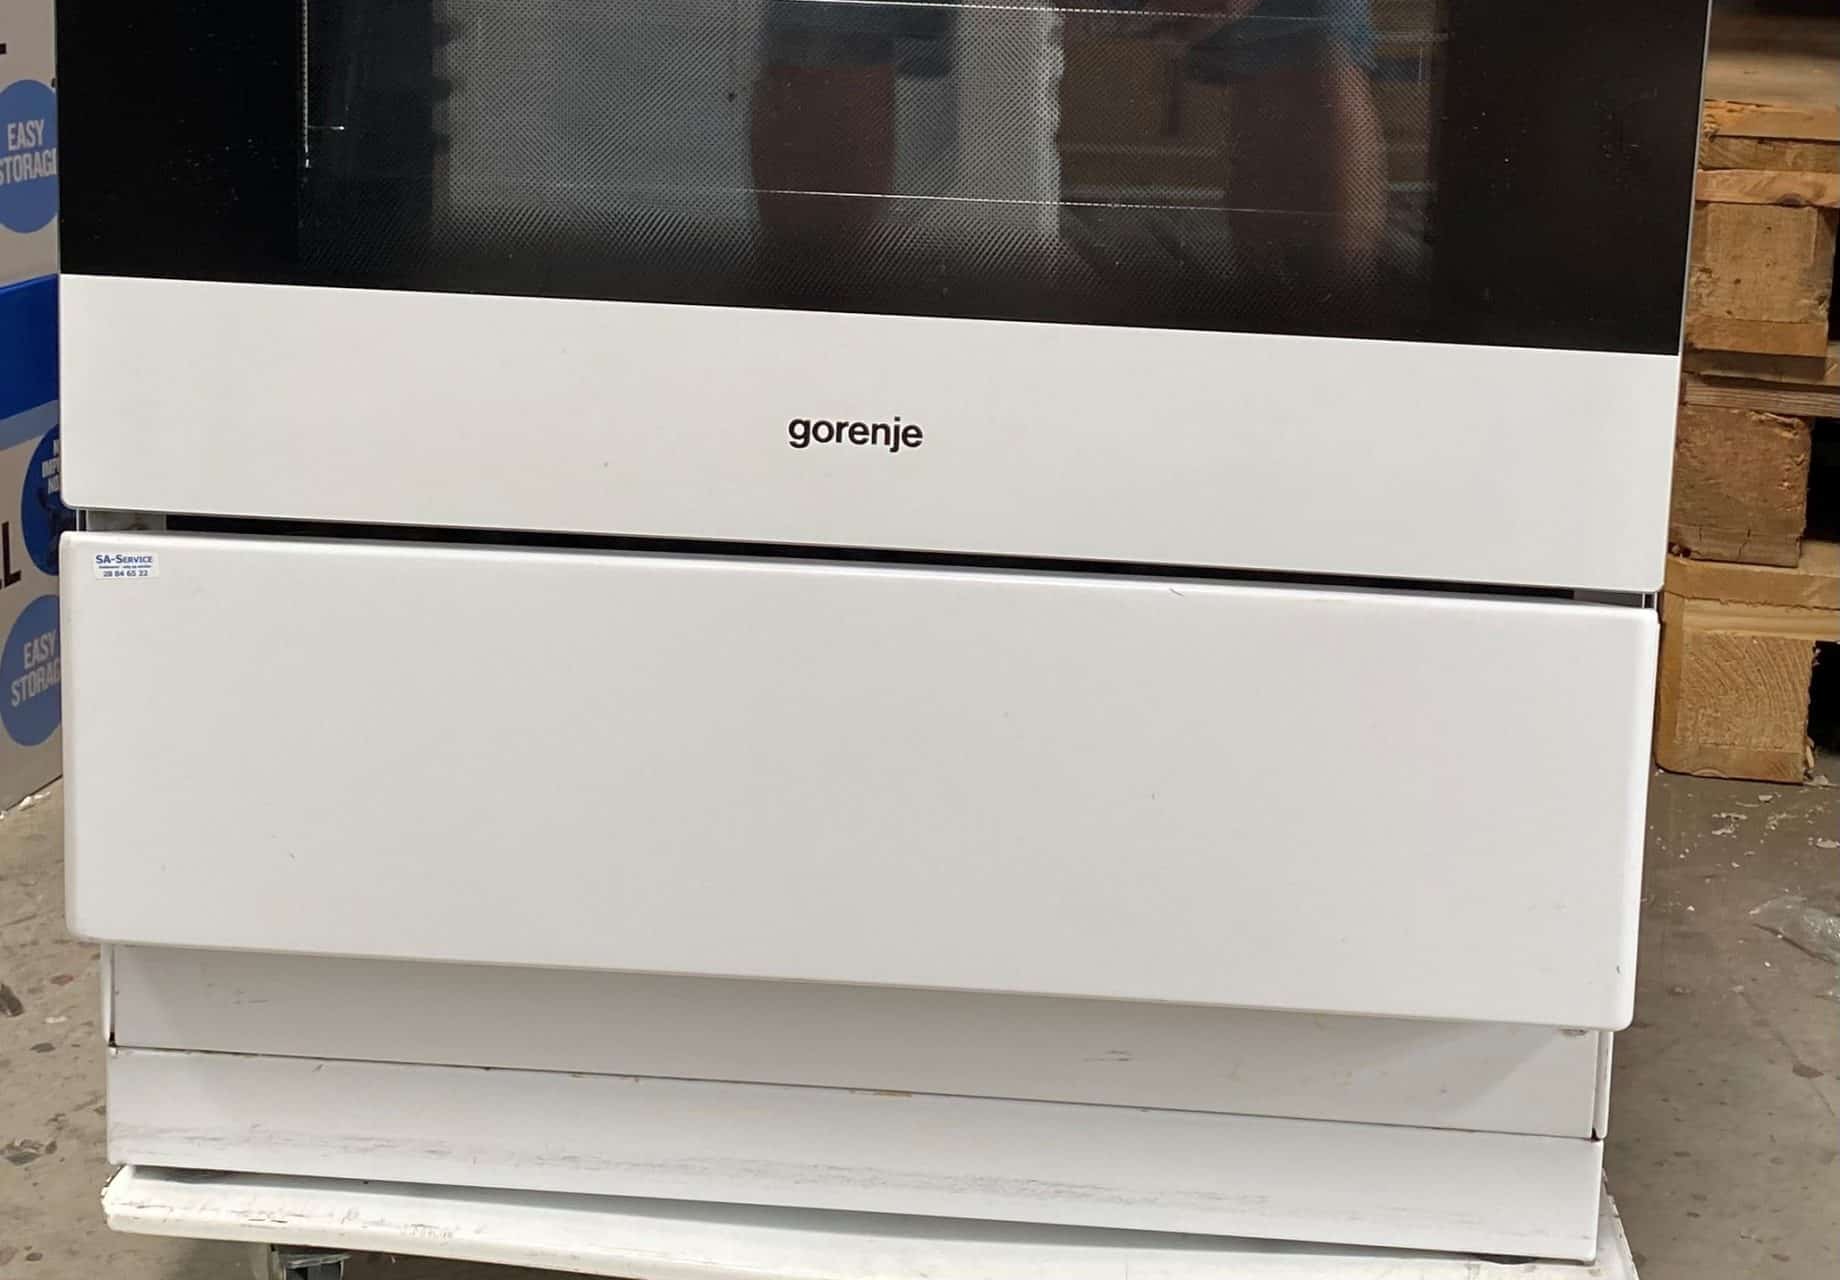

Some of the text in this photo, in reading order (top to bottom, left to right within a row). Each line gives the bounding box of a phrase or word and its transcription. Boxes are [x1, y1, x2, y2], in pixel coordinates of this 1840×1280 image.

[8, 119, 44, 151] EASY
[788, 416, 923, 453] gorenje
[24, 630, 56, 669] EASY
